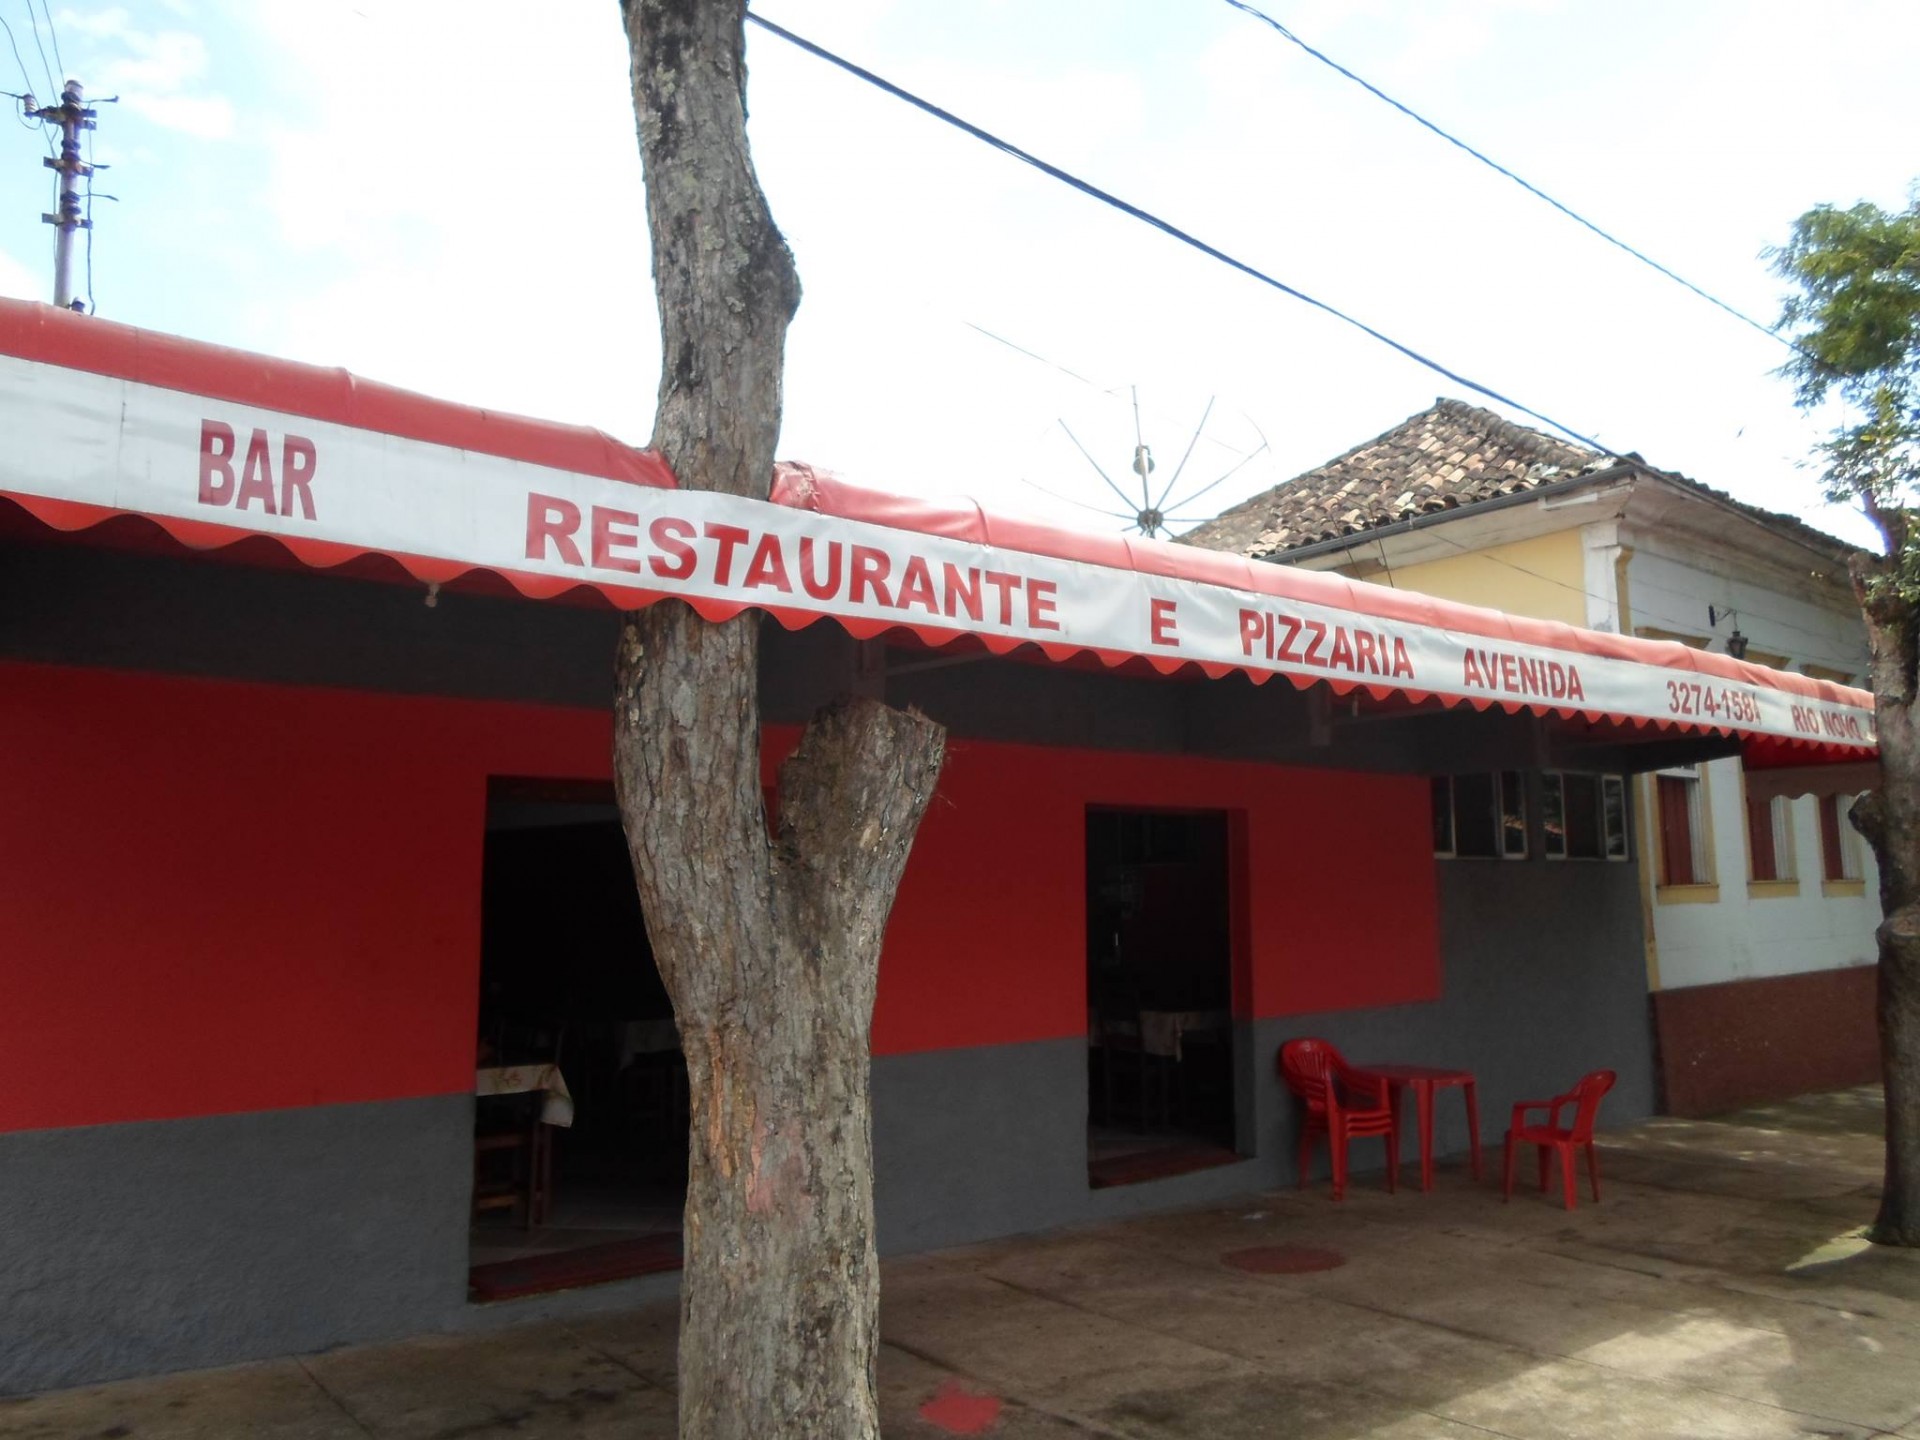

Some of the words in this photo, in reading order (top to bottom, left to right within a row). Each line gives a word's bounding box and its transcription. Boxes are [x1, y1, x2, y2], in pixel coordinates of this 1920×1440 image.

[198, 419, 318, 520] BAR
[525, 492, 1060, 631] RESTAURANTE
[1150, 598, 1179, 647] E
[1240, 609, 1415, 679] PIZZARIA
[1464, 648, 1585, 702] AVENIDA
[1791, 705, 1819, 734] RIO
[1821, 710, 1864, 741] NOVO
